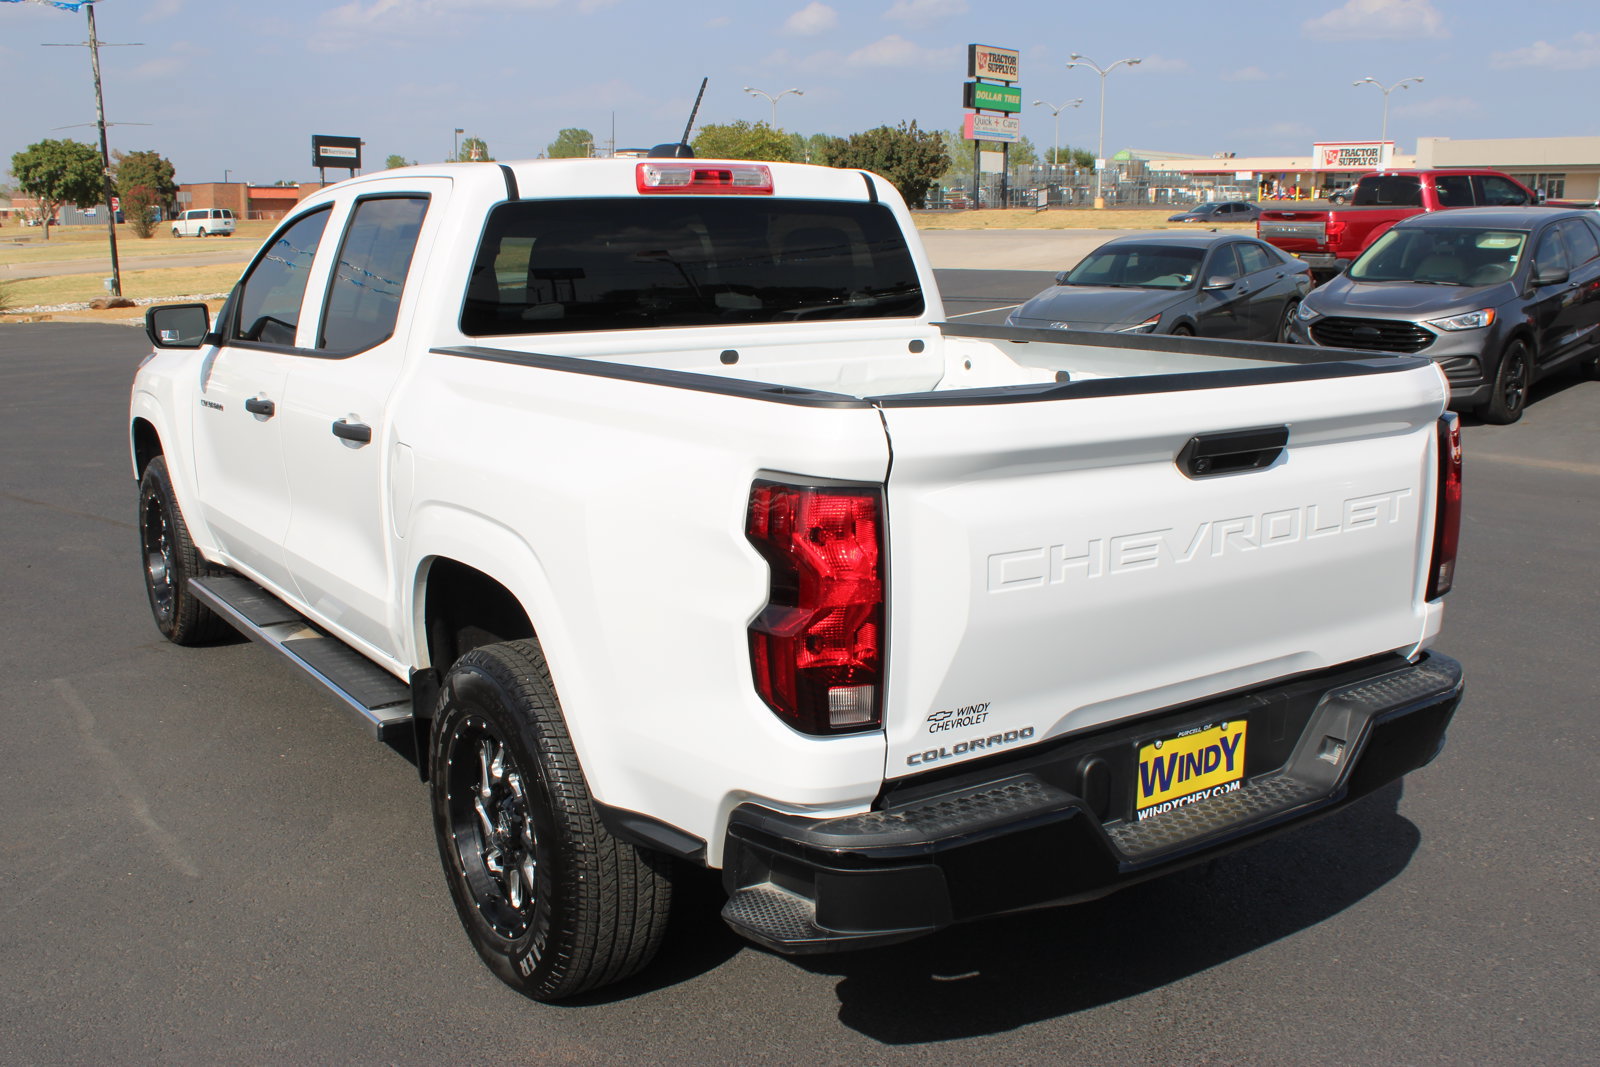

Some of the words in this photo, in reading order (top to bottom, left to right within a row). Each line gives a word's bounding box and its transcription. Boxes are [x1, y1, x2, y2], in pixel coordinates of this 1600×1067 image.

[988, 53, 1016, 65] TRACTOR
[988, 62, 1008, 75] SUPPLY
[976, 91, 1002, 101] DOLLAR
[1005, 95, 1020, 104] TREE
[975, 115, 992, 126] Quick
[1003, 119, 1017, 128] Care
[1339, 148, 1378, 157] TRACTOR
[1338, 157, 1368, 166] SUPPLY
[986, 487, 1412, 594] CHEVROLET
[956, 702, 991, 717] WINDY
[928, 712, 990, 734] CHEVROLET
[1177, 727, 1203, 738] PURCELL
[906, 726, 1036, 767] COLORADO
[1139, 732, 1243, 799] WINDY
